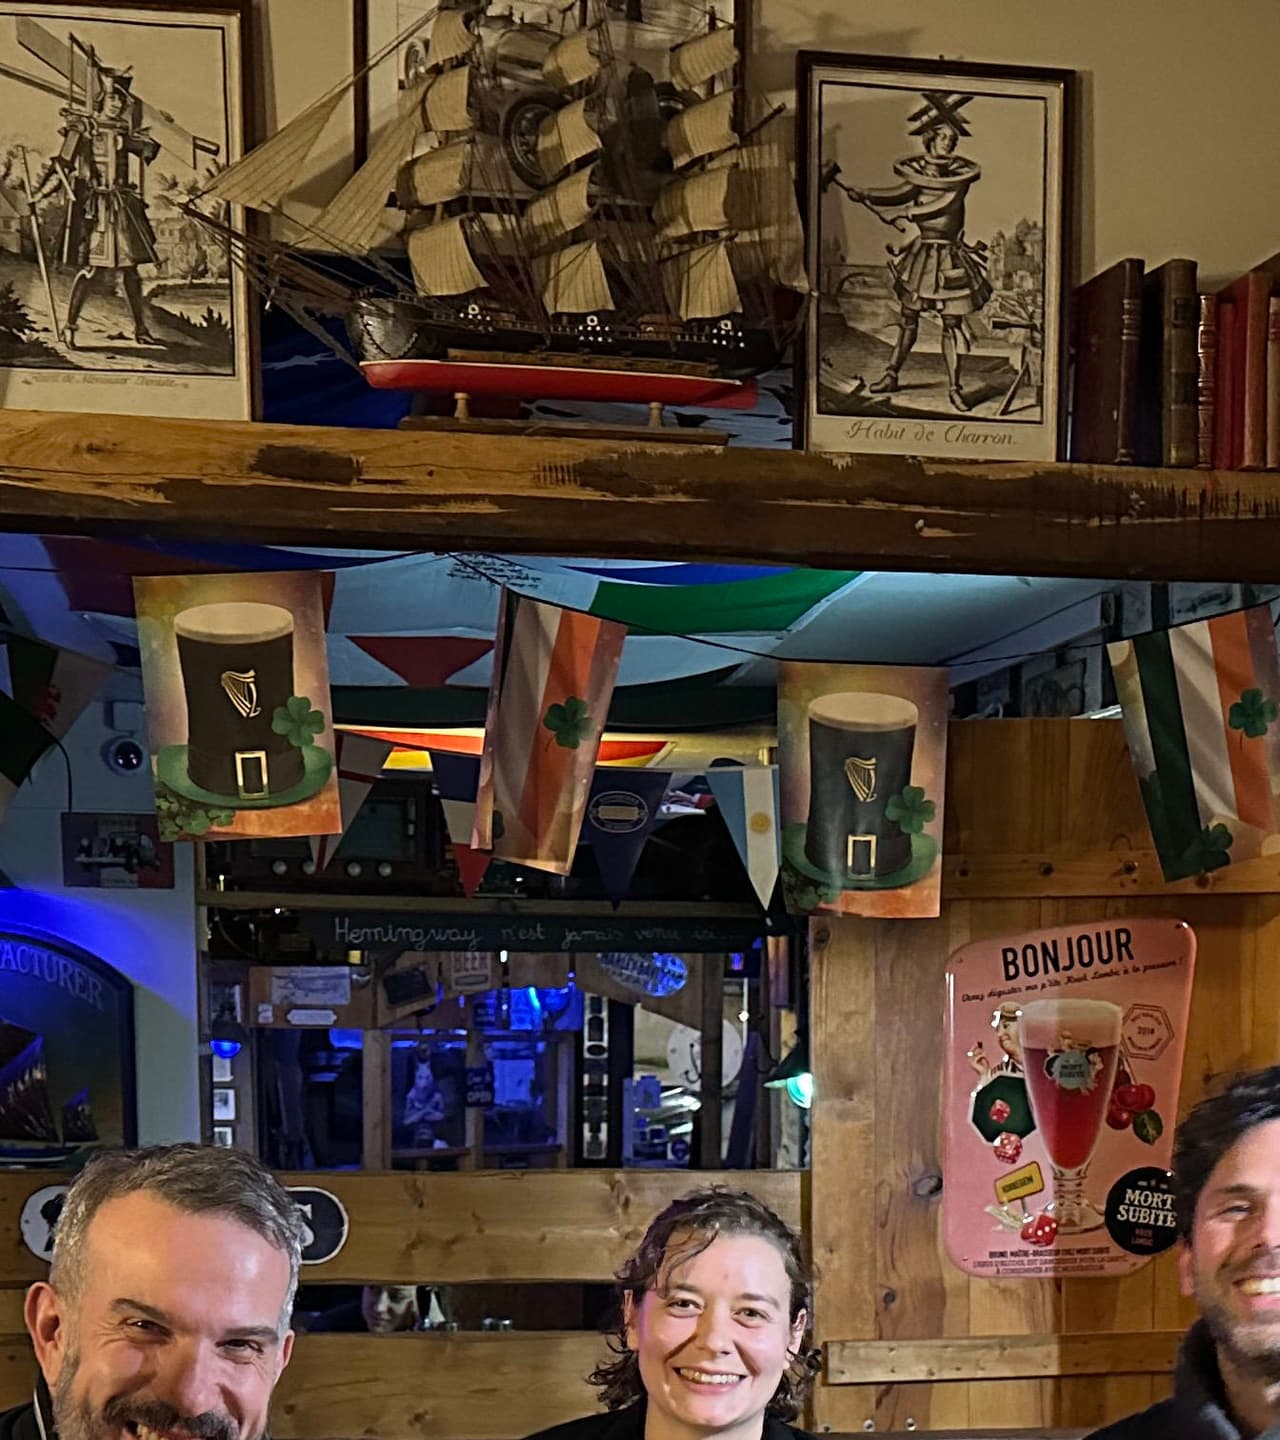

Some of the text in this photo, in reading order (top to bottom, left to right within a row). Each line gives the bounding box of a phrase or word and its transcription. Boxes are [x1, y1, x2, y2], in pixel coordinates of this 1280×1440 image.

[846, 421, 906, 440] Habit
[914, 424, 934, 441] de
[335, 918, 477, 950] Hemingway
[500, 922, 546, 941] n'est
[561, 926, 623, 950] jamais
[1001, 928, 1134, 981] BONJOUR
[1124, 1189, 1175, 1209] MORT
[1117, 1205, 1176, 1228] SUBITE
